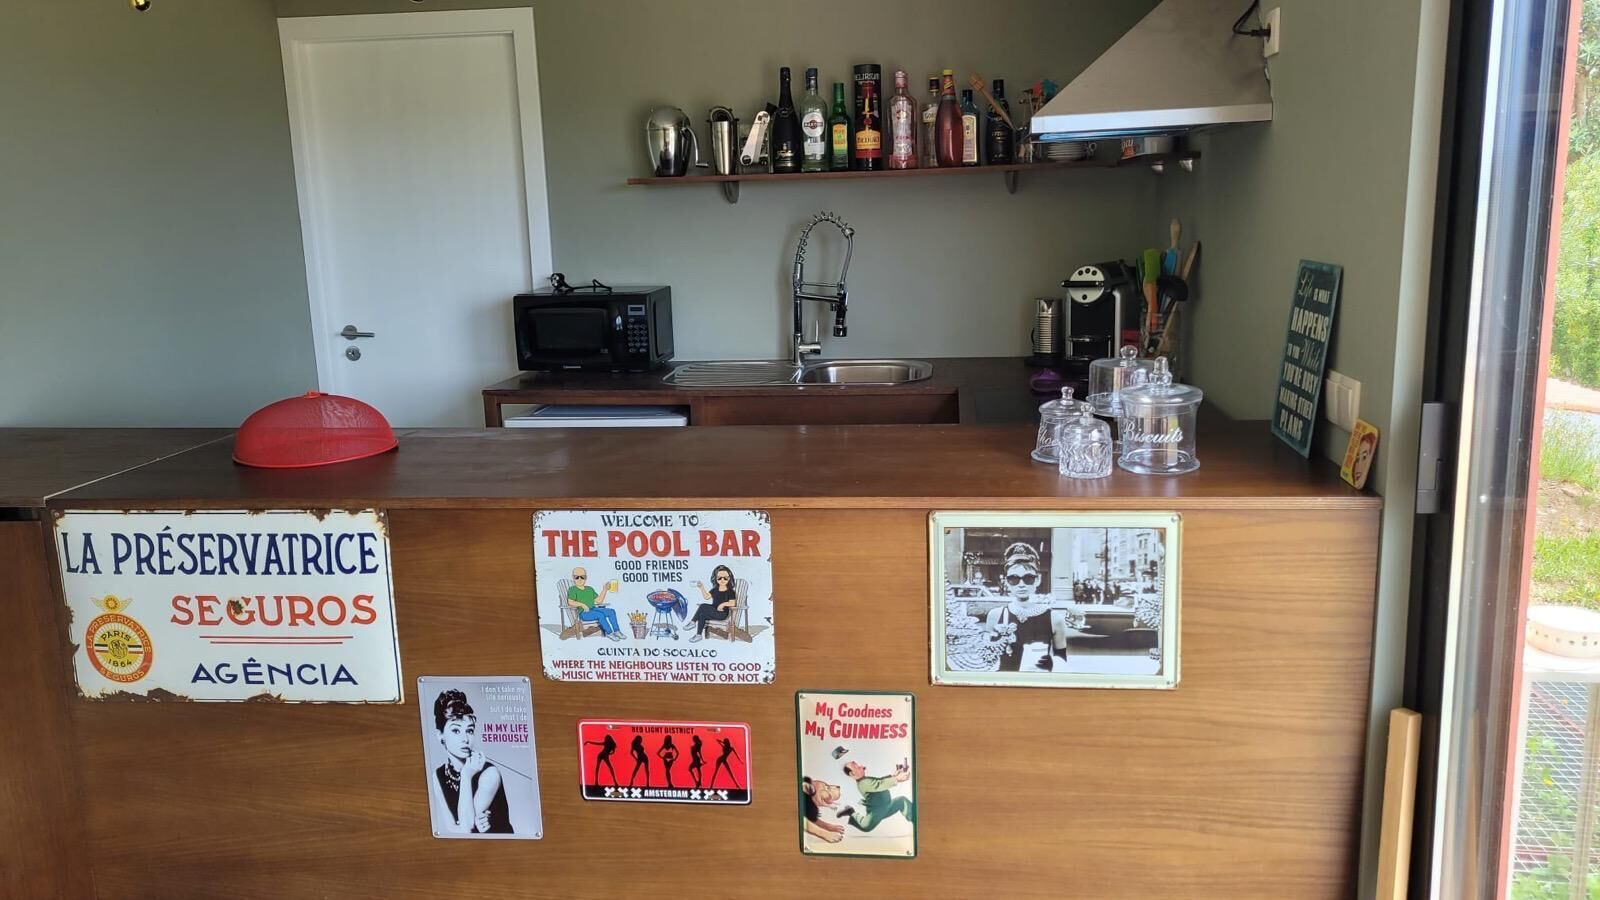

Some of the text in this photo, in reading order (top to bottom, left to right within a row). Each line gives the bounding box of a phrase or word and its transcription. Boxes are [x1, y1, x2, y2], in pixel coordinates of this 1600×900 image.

[1291, 307, 1329, 342] HAPPENS
[1283, 361, 1319, 395] YOU'RE BUSY
[1280, 387, 1313, 420] MAKING OTHER
[1280, 408, 1303, 441] PLANS
[1122, 418, 1184, 444] Biscuits
[601, 515, 699, 527] WELCOME TO
[542, 530, 761, 557] THE POOL BAR
[61, 526, 380, 575] LA PRÉSERVATRICE
[615, 560, 689, 571] GOOD FRIENDS
[622, 572, 683, 583] GOOD TIMES
[171, 595, 377, 627] SEGUROS
[101, 630, 132, 641] PARIS
[597, 648, 718, 658] QUINTA DO SOCALCO
[109, 659, 132, 668] 1864
[552, 660, 761, 672] WHERE THE NEIGHBOURS LISTEN TO GOOD
[191, 657, 359, 686] AGÊNCIA
[561, 670, 760, 682] MUSIC WHETHER THEY WANT TO OR NOT
[501, 685, 516, 693] take
[490, 705, 500, 713] but
[505, 705, 513, 713] do
[815, 702, 893, 720] My Goodness
[483, 723, 529, 733] IN MY LIFE
[805, 720, 908, 740] My GUINNESS
[482, 733, 529, 743] SERIOUSLY
[644, 789, 689, 798] AMSTERDAM
